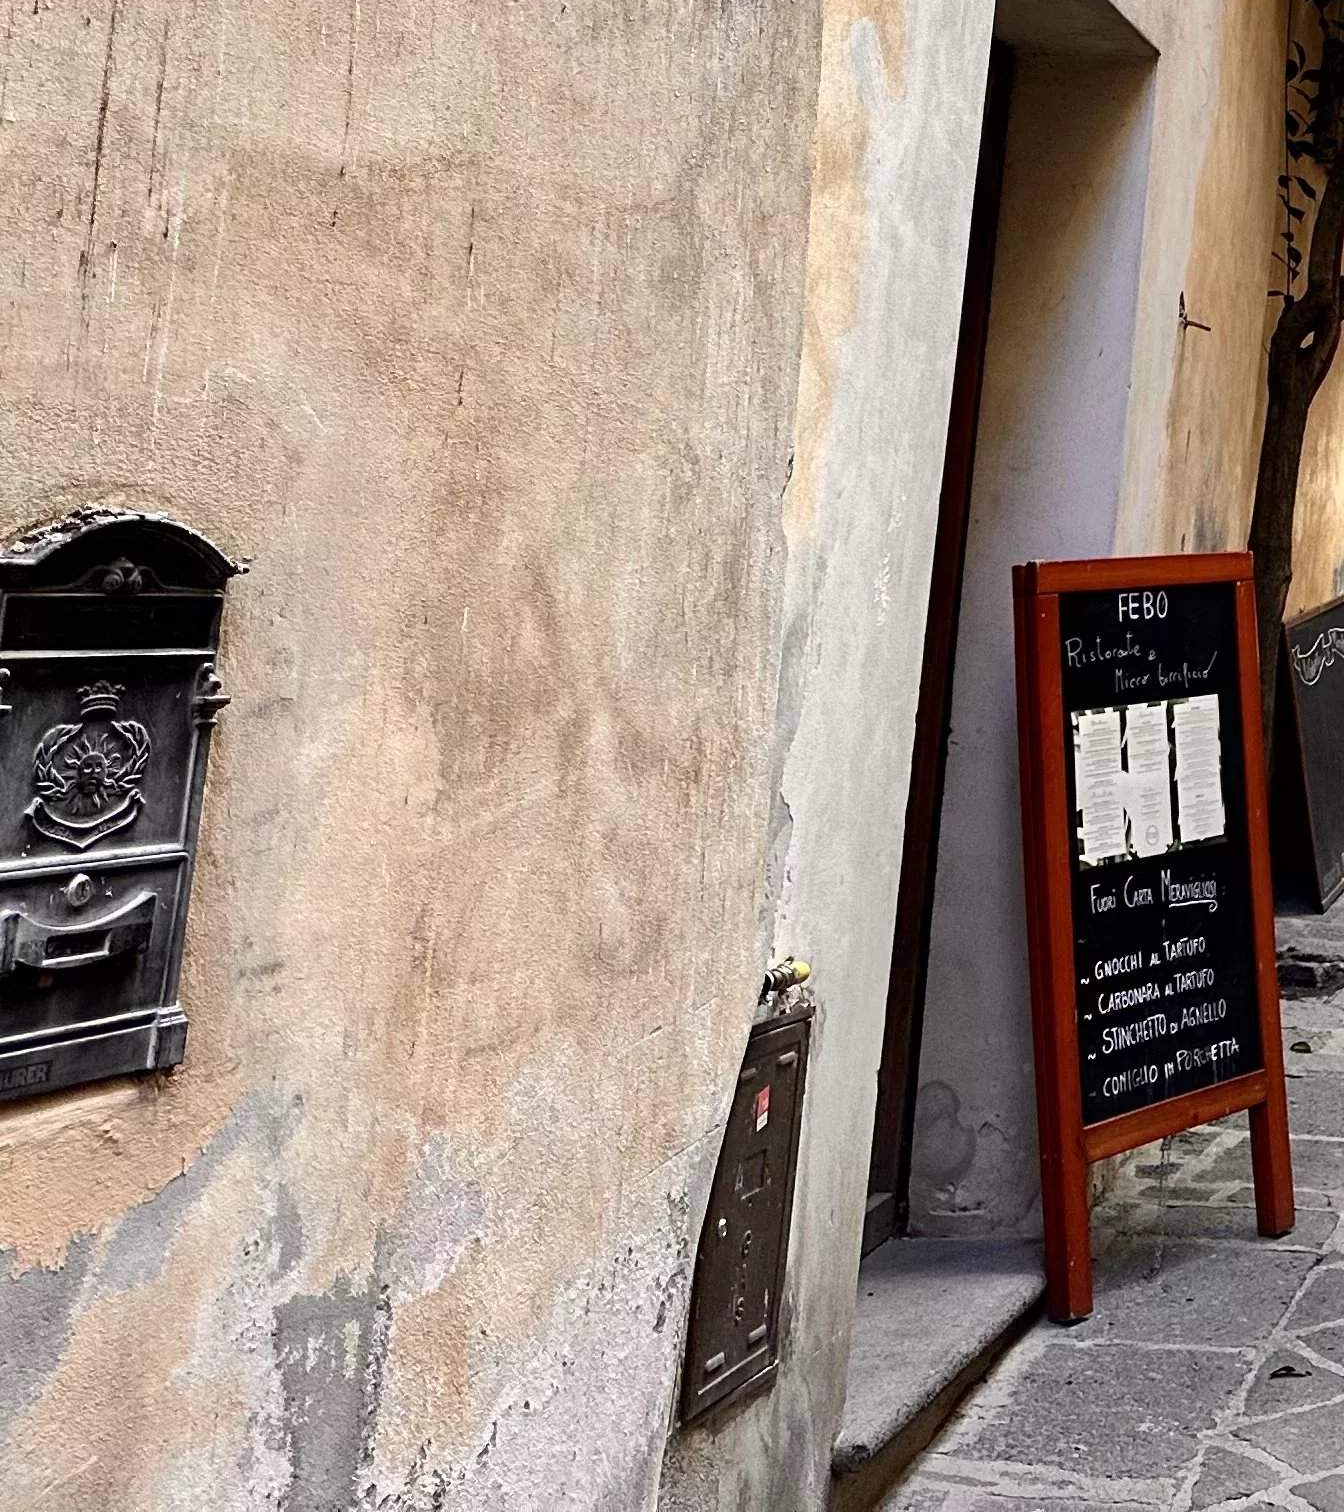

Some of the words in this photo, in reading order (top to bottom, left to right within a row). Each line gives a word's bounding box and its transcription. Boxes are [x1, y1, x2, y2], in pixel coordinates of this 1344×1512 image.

[1118, 590, 1168, 623] FEBO
[1094, 950, 1143, 980] GNOCCHI
[1162, 936, 1206, 963] TARTUFO
[1098, 982, 1160, 1015] CARBONARA
[1174, 968, 1215, 993] TARTUFO
[1102, 1013, 1167, 1055] STINCHETTO
[1180, 998, 1227, 1031] AGNELLO
[0, 1064, 47, 1089] URER
[1103, 1064, 1158, 1097] CONIGLIO
[1176, 1036, 1241, 1072] PORCHETTA
